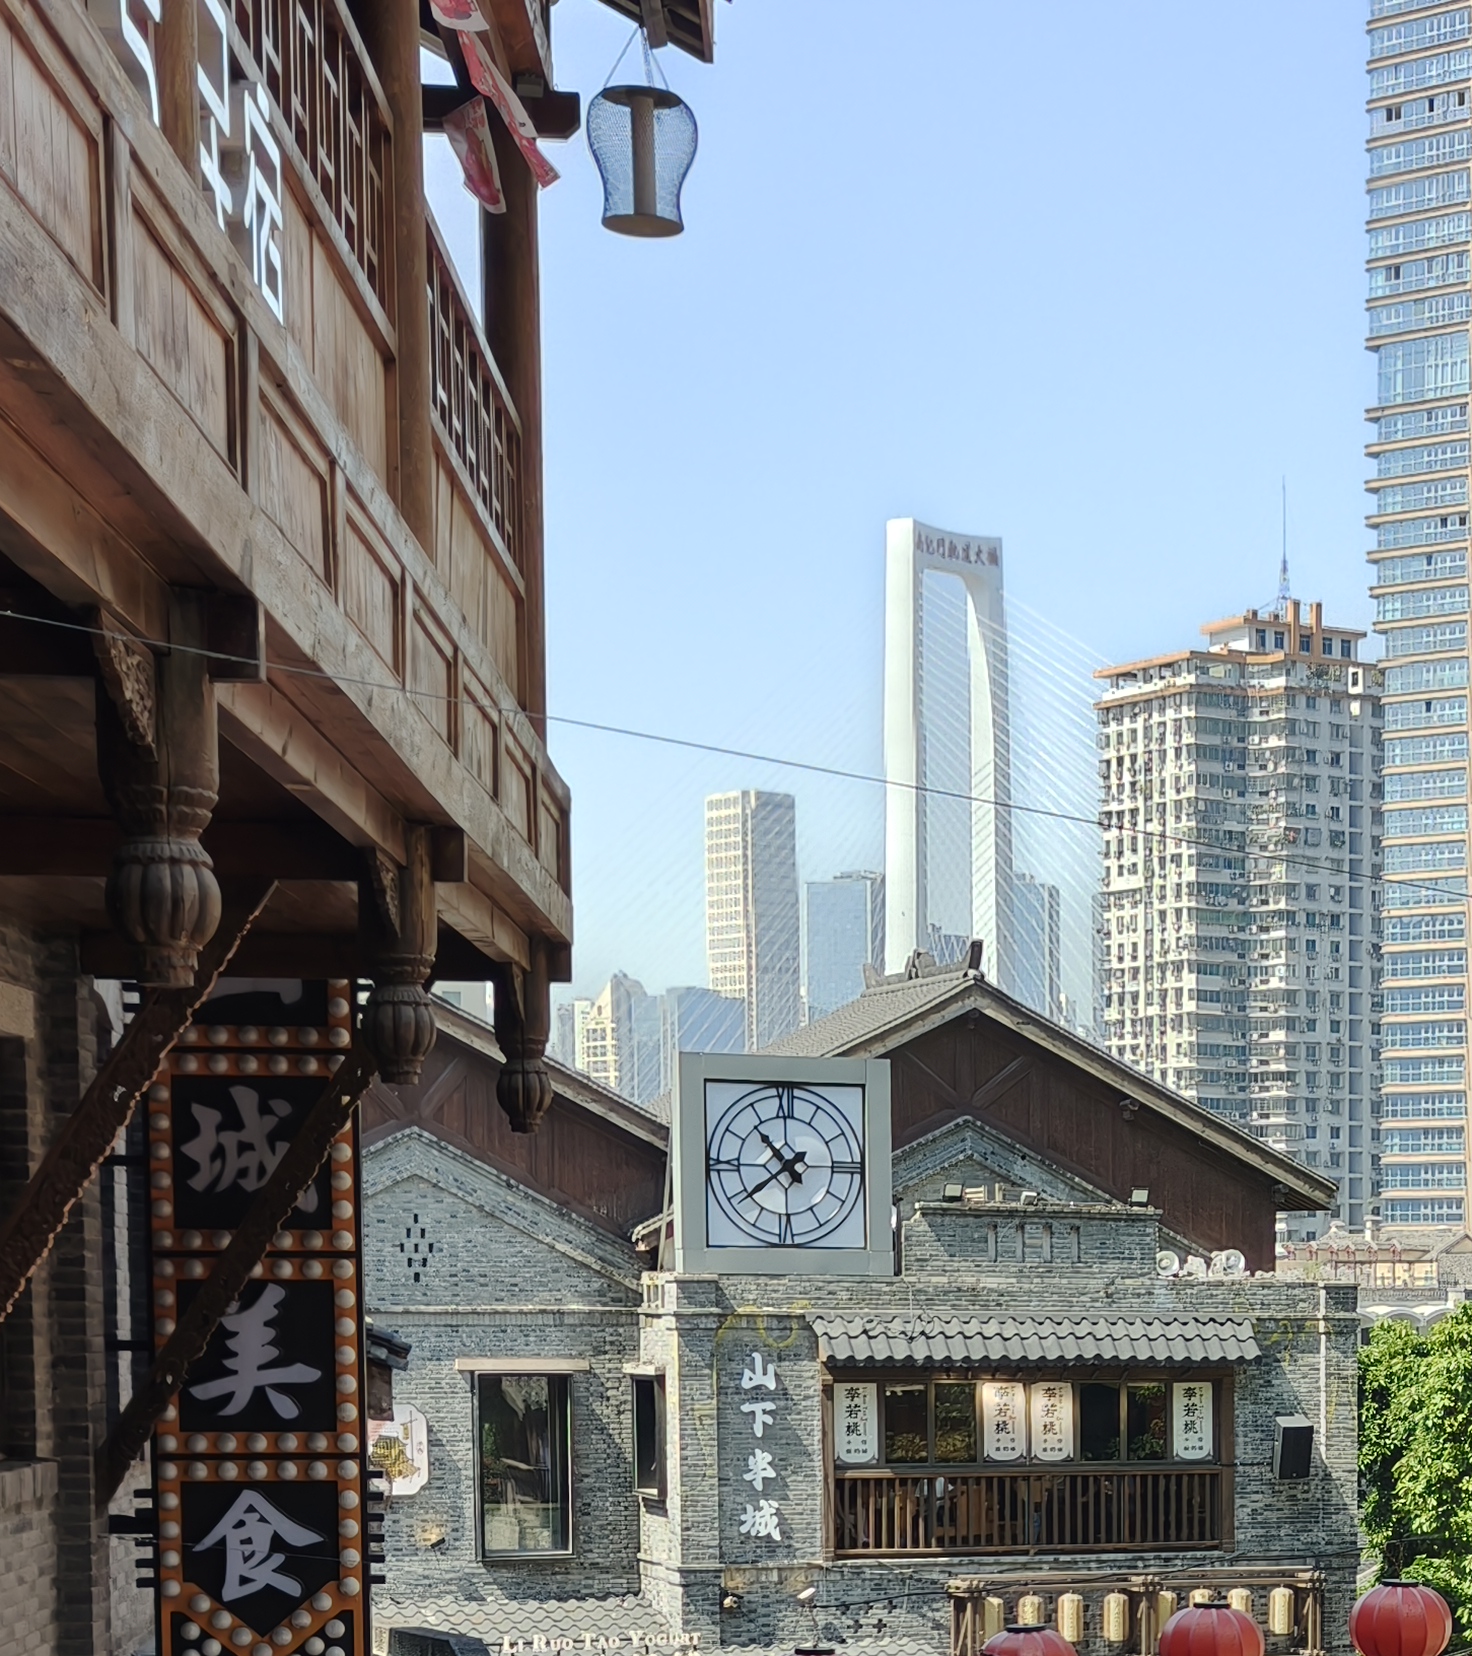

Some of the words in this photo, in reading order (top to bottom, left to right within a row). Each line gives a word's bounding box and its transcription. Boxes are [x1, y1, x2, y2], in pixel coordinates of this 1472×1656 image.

[180, 977, 325, 1603] 城美食
[740, 1352, 782, 1541] 山下半城
